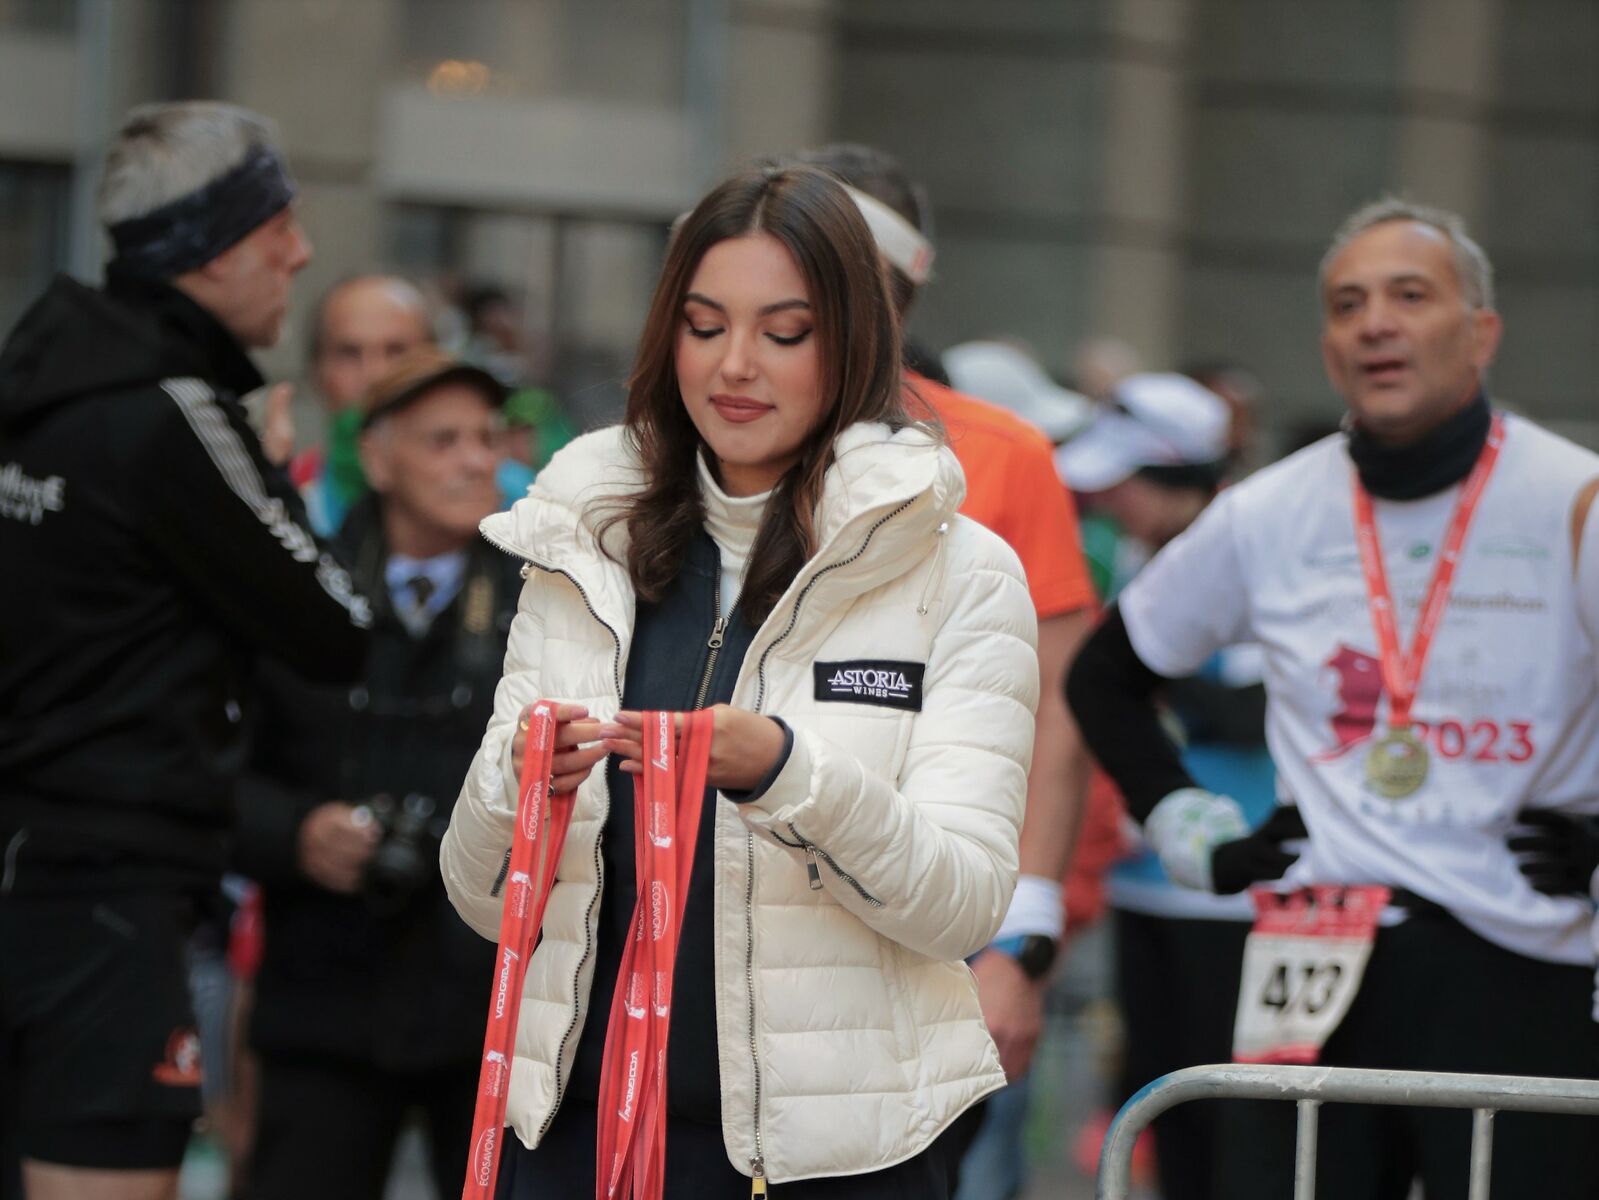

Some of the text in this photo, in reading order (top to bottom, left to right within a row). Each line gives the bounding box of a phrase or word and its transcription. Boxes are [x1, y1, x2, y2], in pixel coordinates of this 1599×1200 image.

[828, 670, 912, 691] ASTORIA
[853, 686, 888, 698] WINES
[527, 780, 543, 840] ECOSAVONA
[652, 880, 662, 942] ECOSAVONA
[479, 1128, 496, 1186] ECOSAVONA
